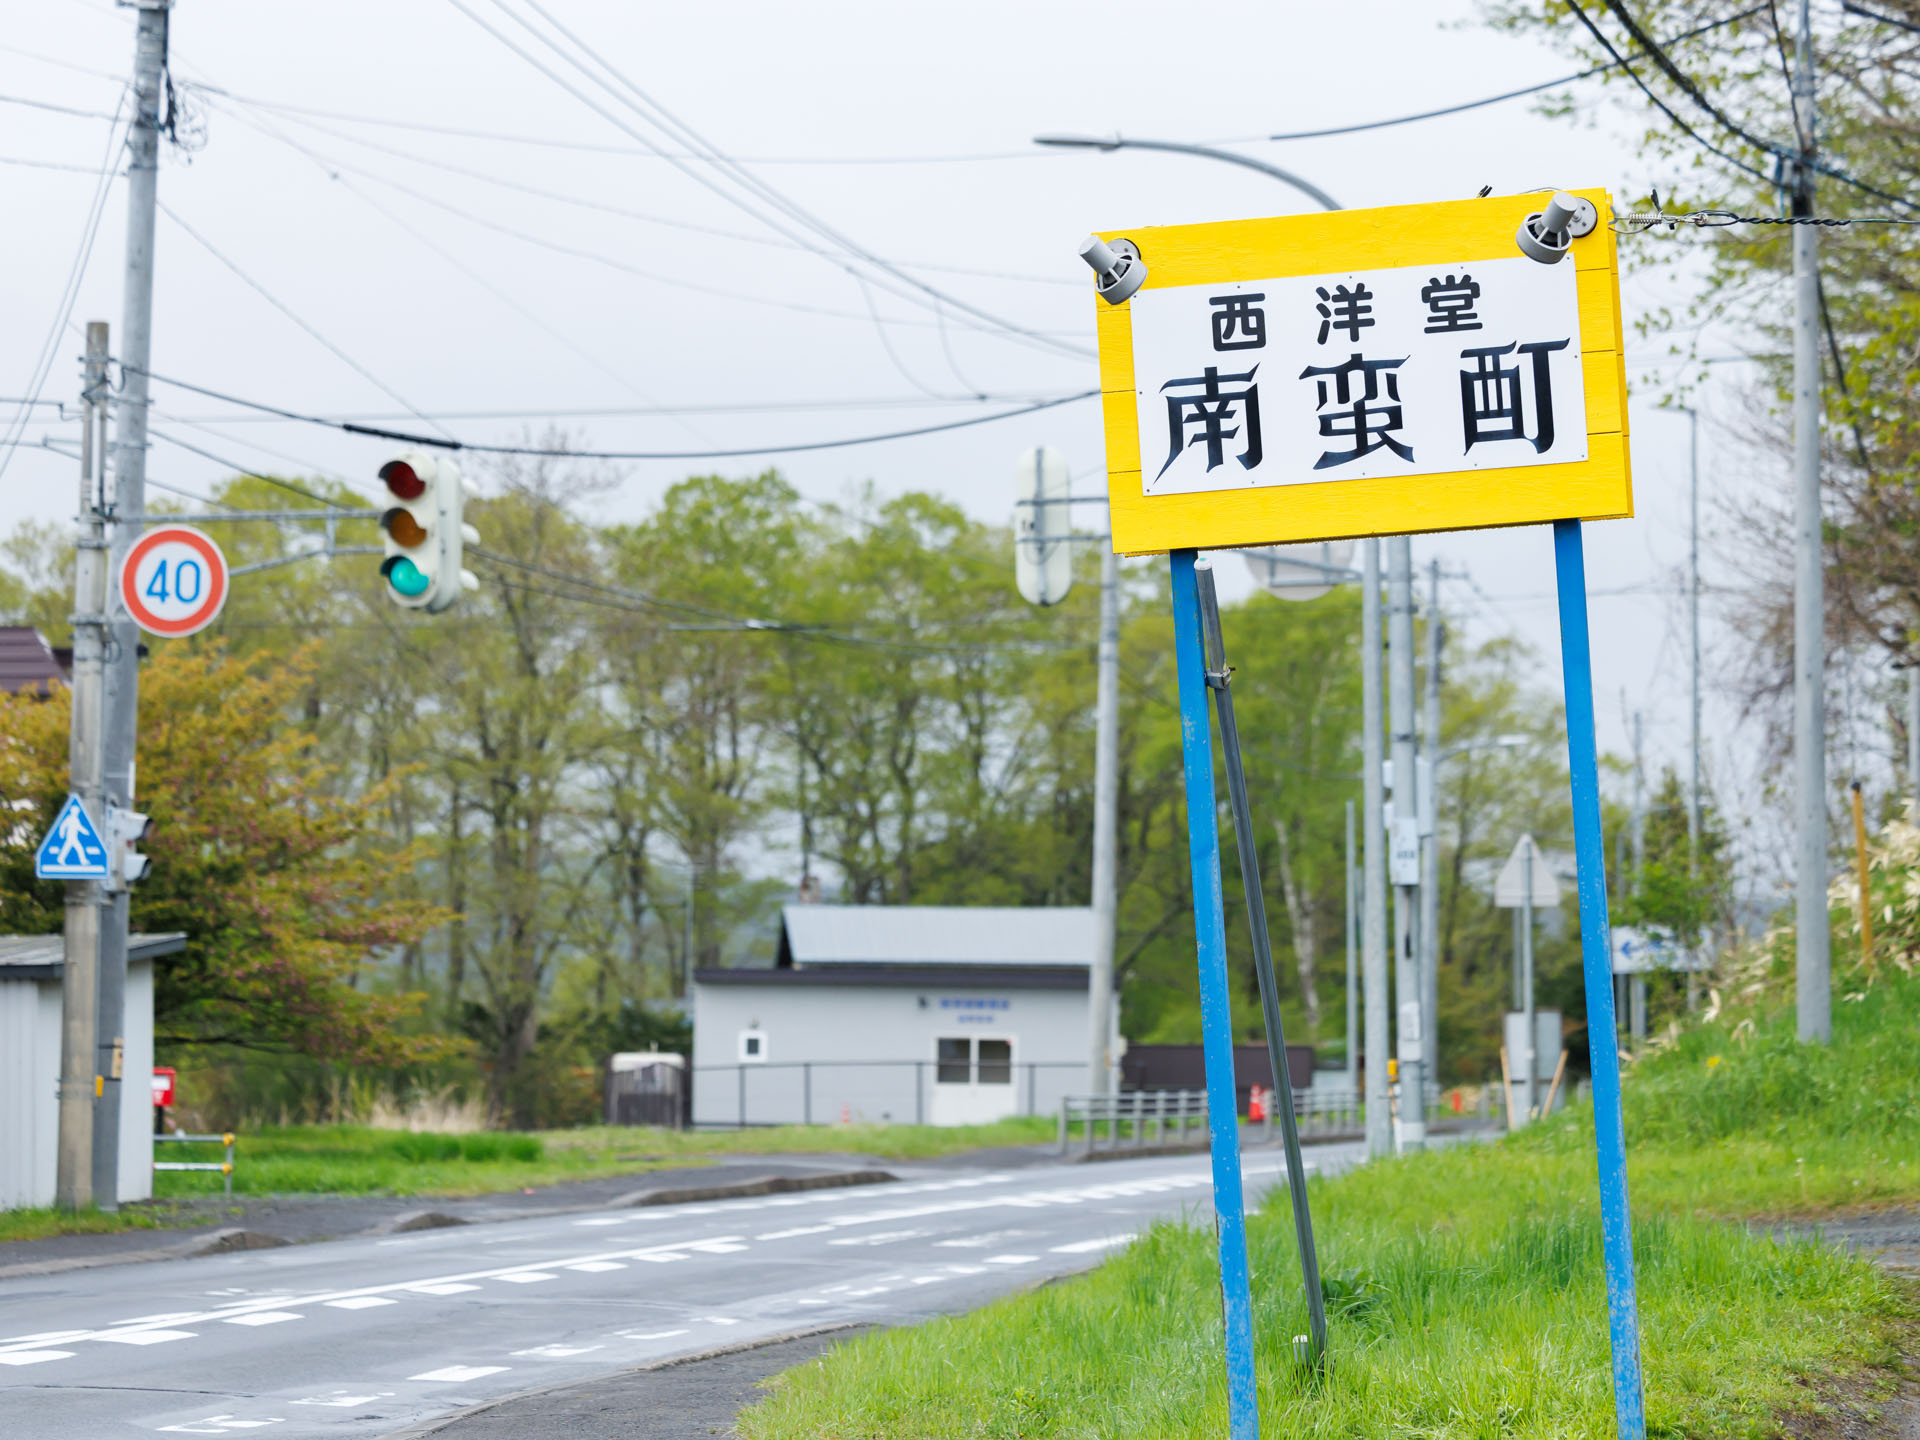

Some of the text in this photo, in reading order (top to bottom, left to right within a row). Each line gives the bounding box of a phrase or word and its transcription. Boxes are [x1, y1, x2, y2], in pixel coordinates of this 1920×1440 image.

[1209, 274, 1483, 352] 西洋堂
[1153, 337, 1571, 485] 南蛮酊
[146, 559, 201, 603] 40
